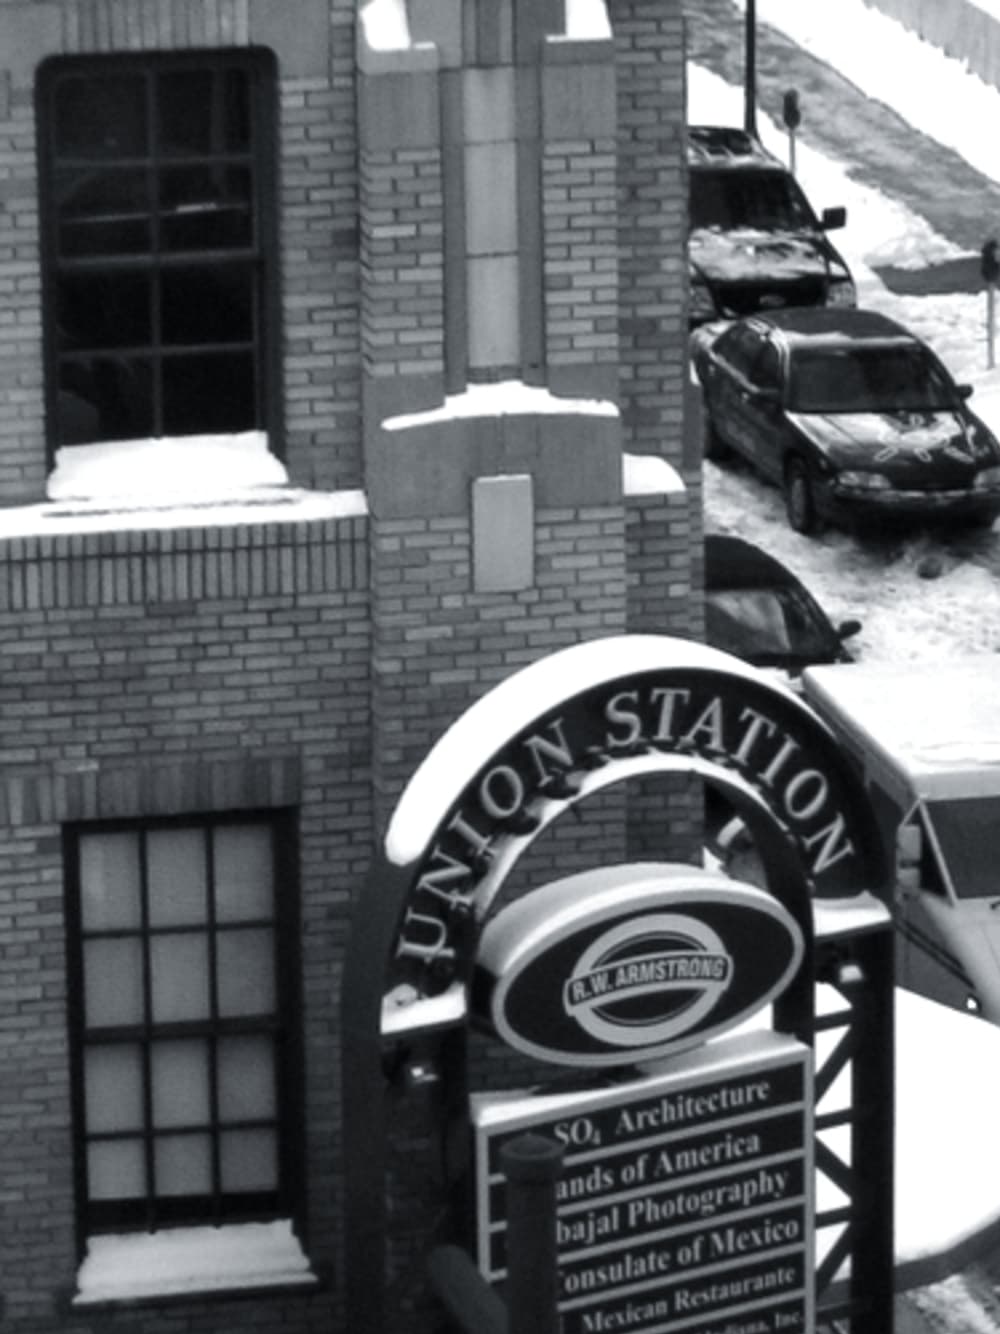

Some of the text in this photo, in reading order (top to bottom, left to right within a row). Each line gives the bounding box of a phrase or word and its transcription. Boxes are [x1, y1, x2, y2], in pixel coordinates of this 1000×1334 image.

[397, 687, 855, 960] UNION STATION
[615, 957, 726, 988] ARMSTRONG
[615, 1080, 770, 1136] Architecture
[556, 1131, 761, 1200] ands of America
[556, 1167, 789, 1245] bajal Photography
[559, 1217, 800, 1295] onsulate of Mexico
[674, 1265, 796, 1312] Restaurante
